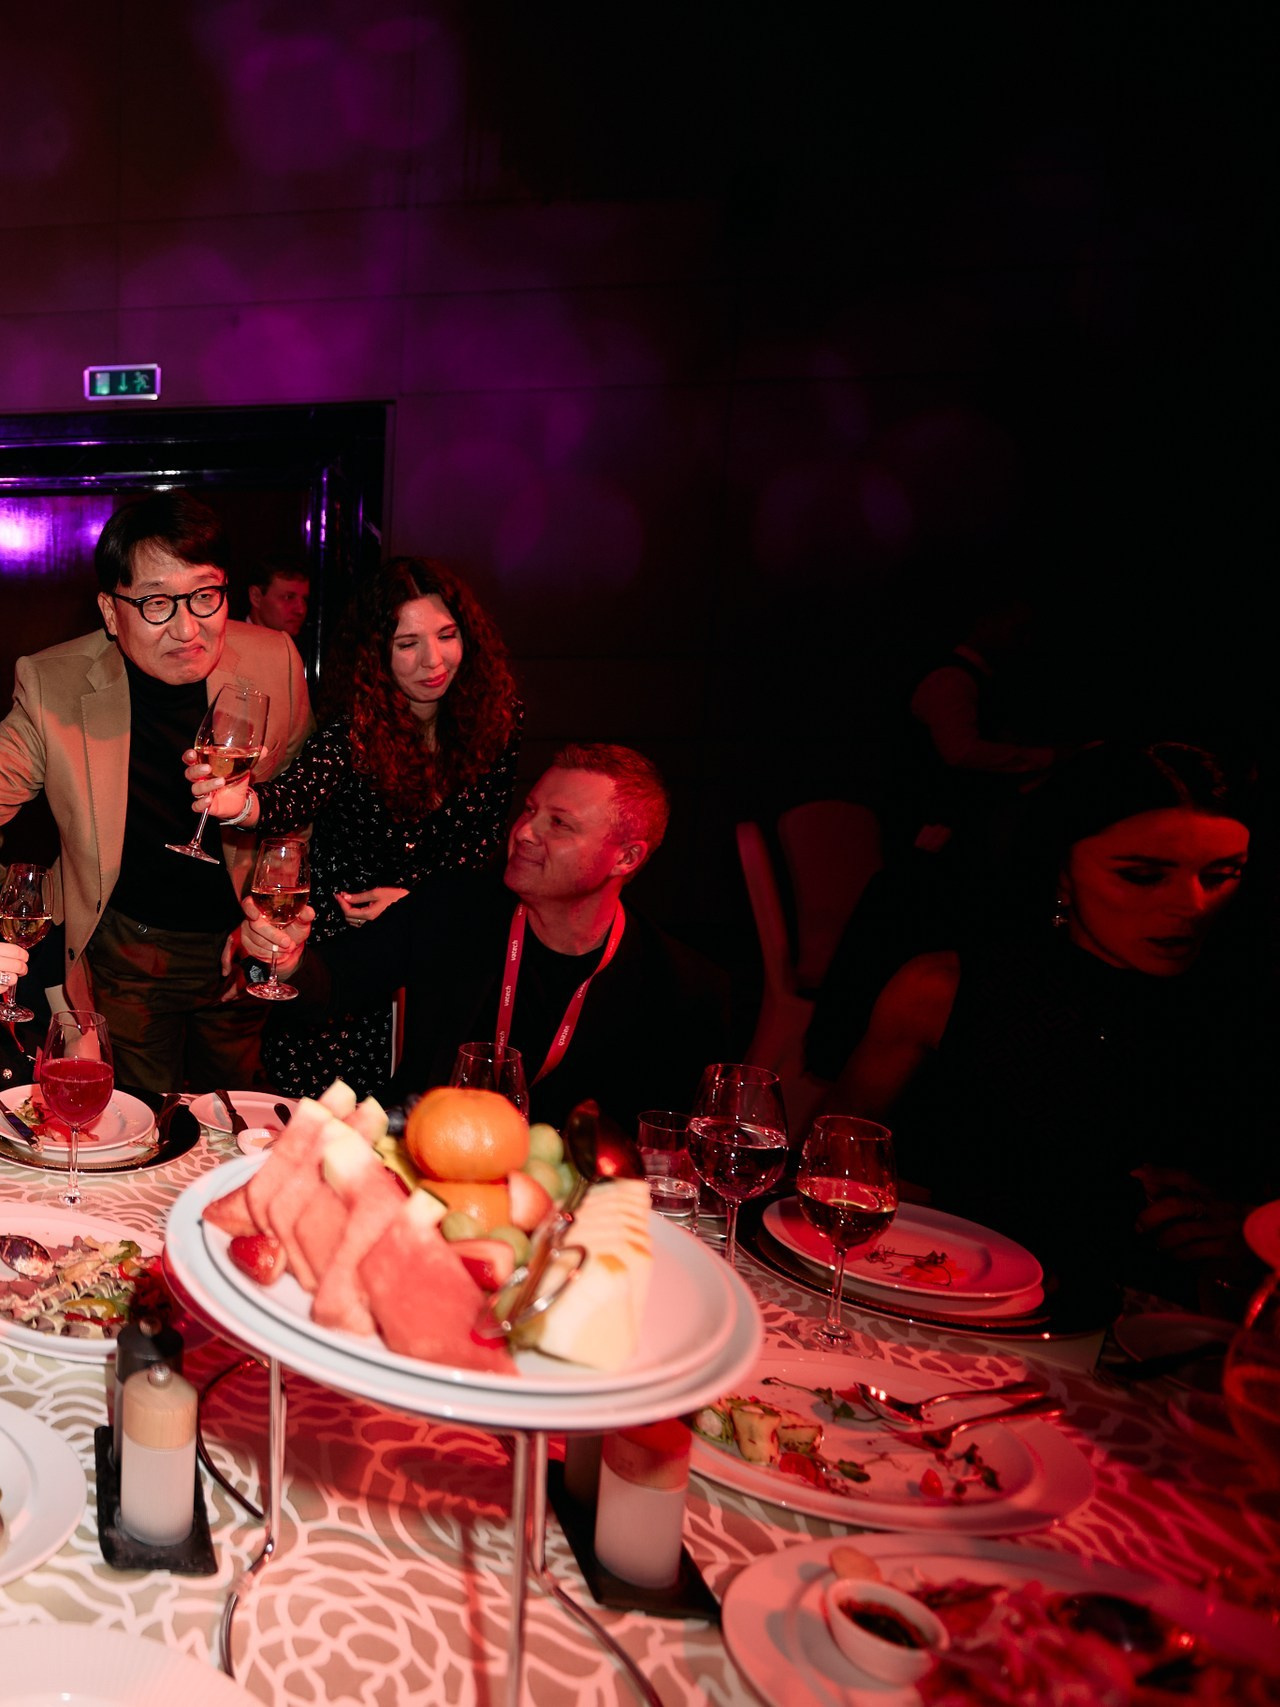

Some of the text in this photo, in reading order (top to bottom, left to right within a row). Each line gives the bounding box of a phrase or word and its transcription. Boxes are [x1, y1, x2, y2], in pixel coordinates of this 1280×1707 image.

[511, 939, 519, 961] vatech
[504, 985, 512, 1007] vatech
[559, 1025, 570, 1046] vatech
